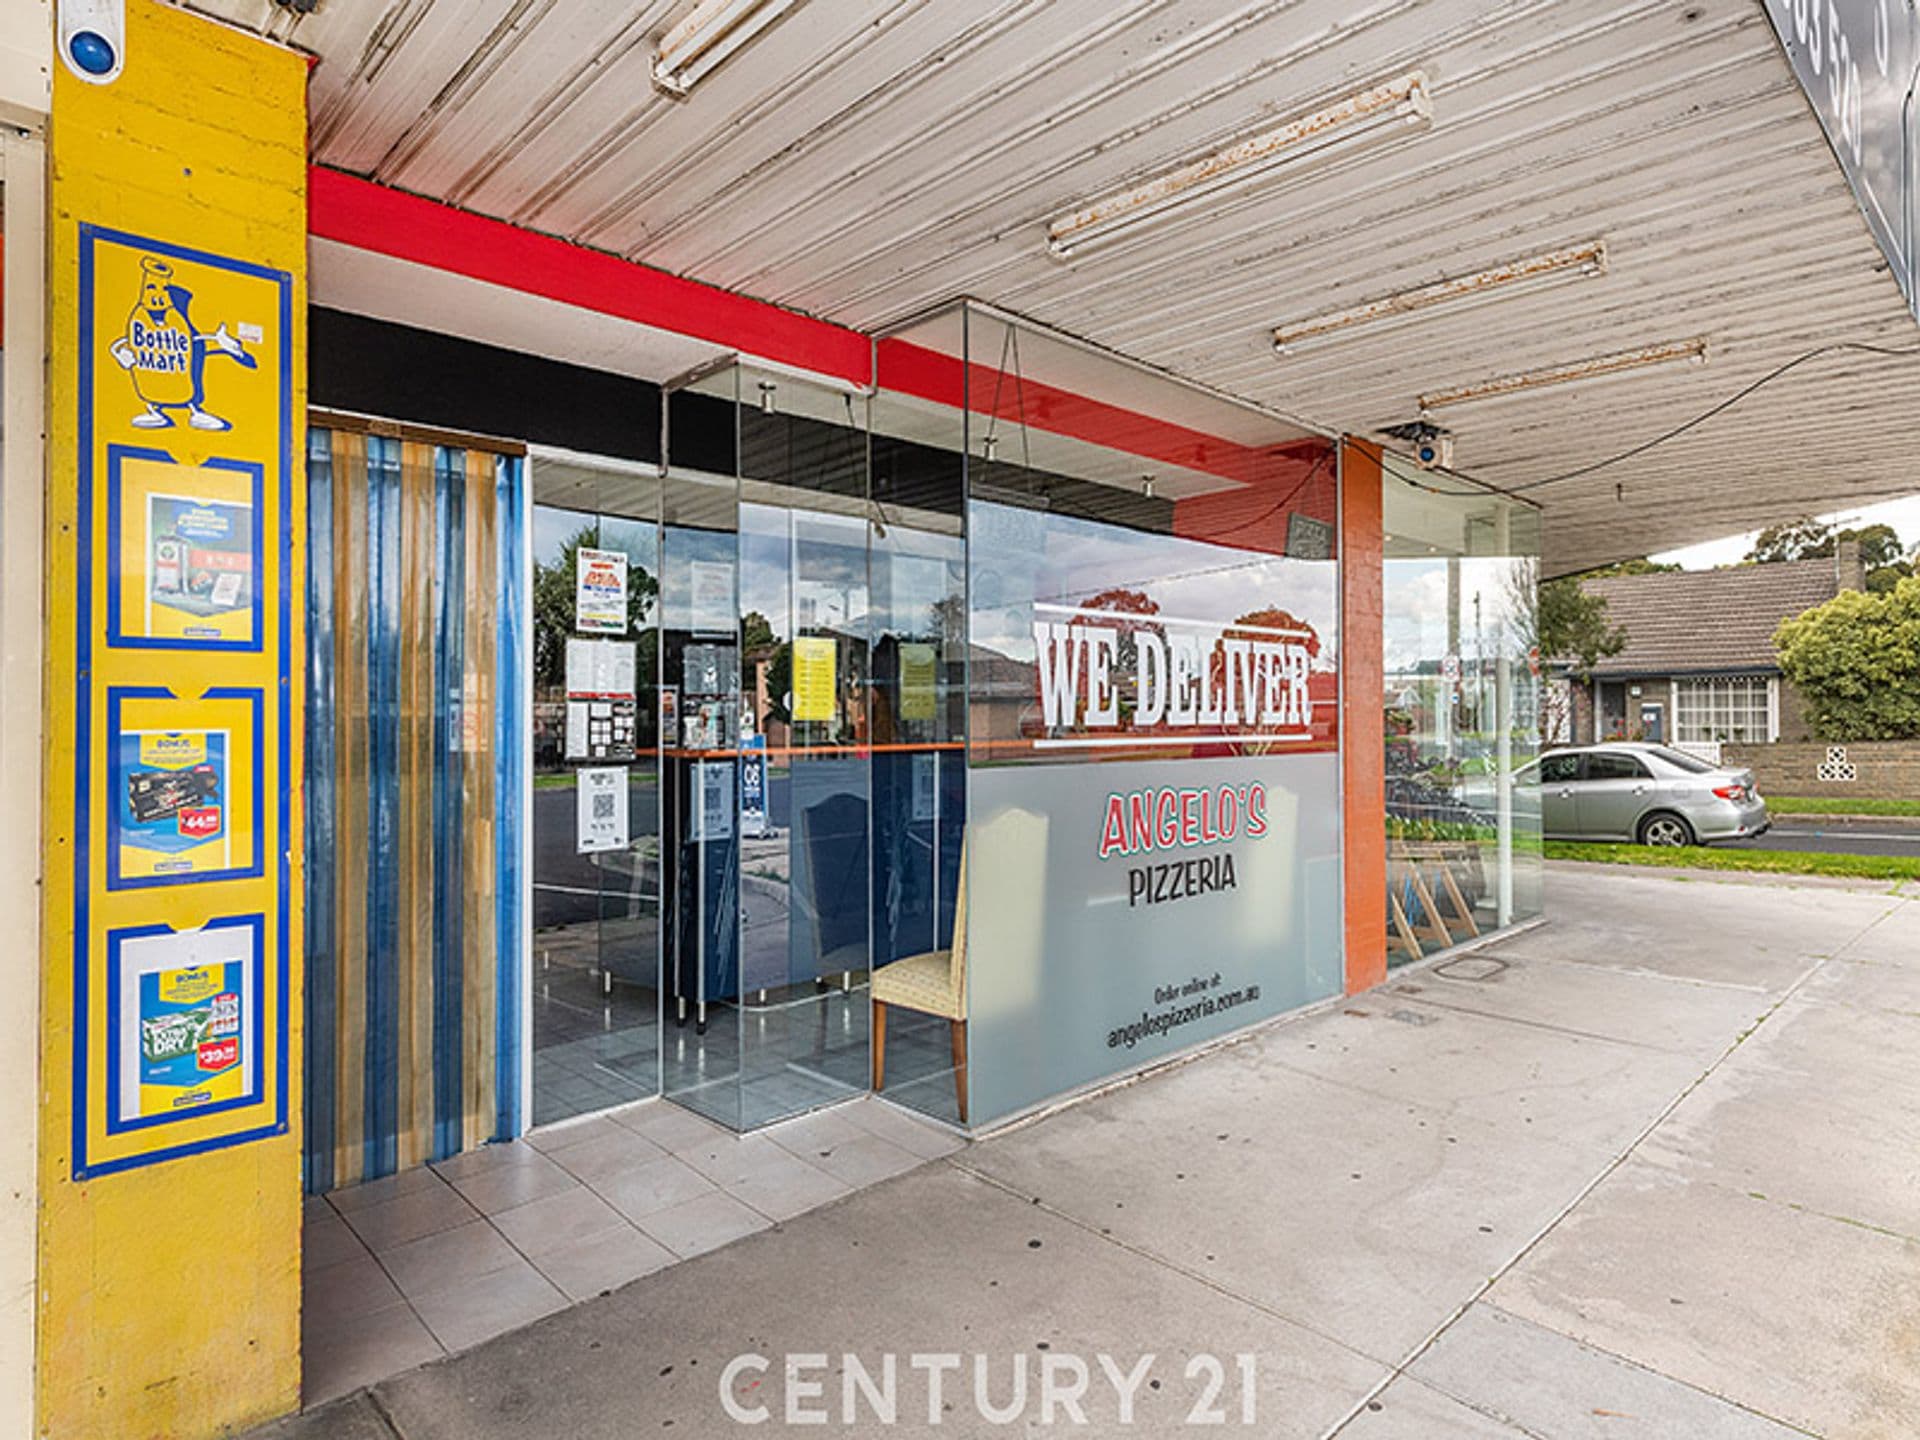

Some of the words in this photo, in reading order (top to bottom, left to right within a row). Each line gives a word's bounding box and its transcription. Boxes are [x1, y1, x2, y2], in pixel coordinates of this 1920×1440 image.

[133, 321, 188, 351] Bottle
[139, 350, 186, 371] Mart
[1034, 622, 1117, 726] WE
[1098, 781, 1267, 860] ANGELO'S
[1128, 853, 1236, 907] PIZZERIA
[1107, 985, 1260, 1049] angelospizzeria.com.au
[1154, 985, 1180, 1005] Order
[1182, 977, 1208, 996] online
